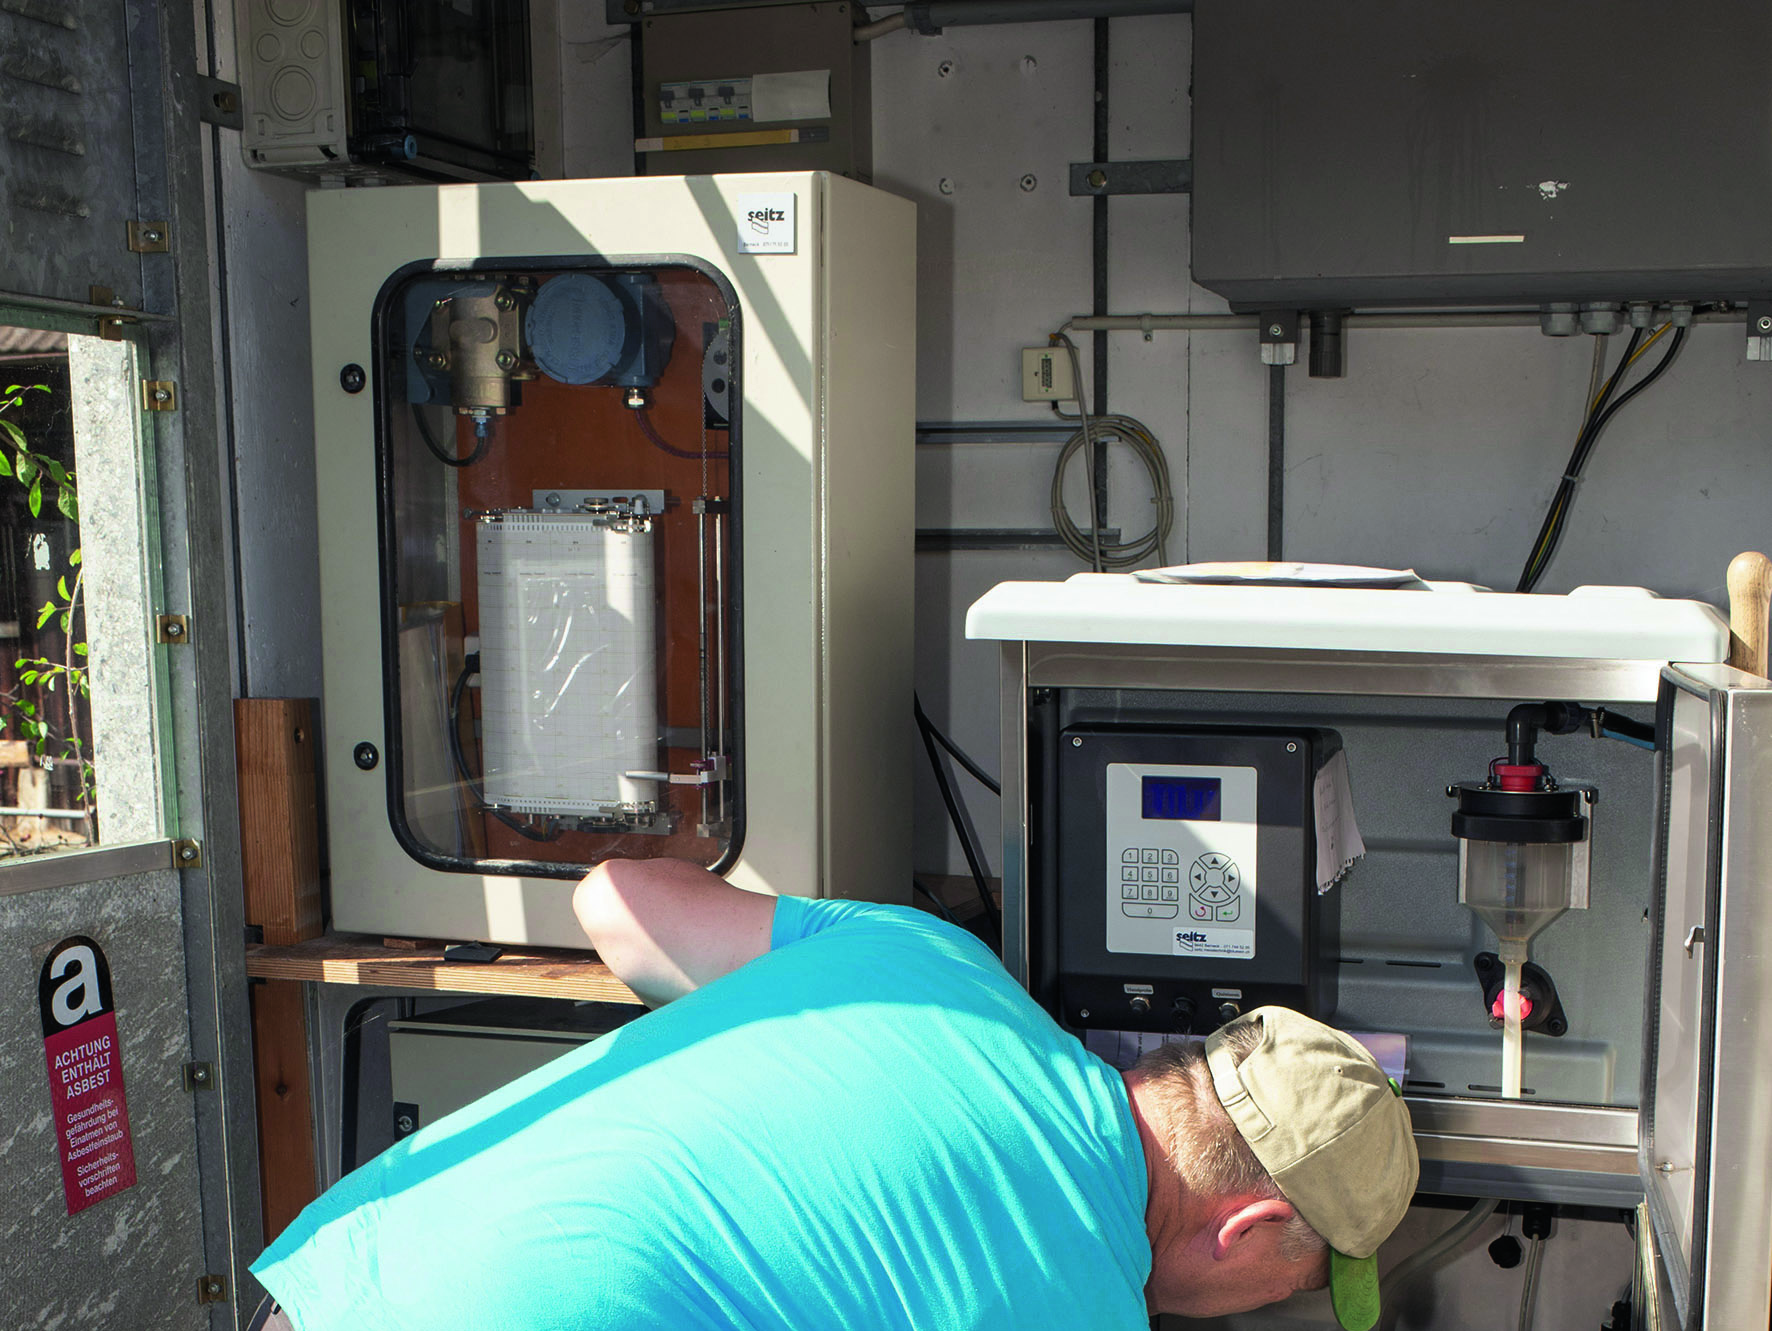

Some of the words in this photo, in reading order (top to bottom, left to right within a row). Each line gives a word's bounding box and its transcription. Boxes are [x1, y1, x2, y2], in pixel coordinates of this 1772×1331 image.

[747, 207, 785, 222] seitz
[1176, 931, 1207, 942] seitz
[50, 945, 103, 1026] a
[55, 1035, 111, 1069] ACHTUNG
[61, 1052, 111, 1083] ENTHÄLT
[67, 1069, 110, 1099] ASBEST
[65, 1113, 106, 1139] gefährdung
[107, 1106, 119, 1118] bei
[67, 1099, 114, 1124] Gesundheits-
[67, 1130, 123, 1162] Asbestfeinstaub
[70, 1127, 104, 1148] Einatmen
[105, 1121, 117, 1132] von
[77, 1152, 119, 1176] Sicherheits-
[78, 1162, 120, 1188] vorschriften
[84, 1176, 118, 1197] beachten
